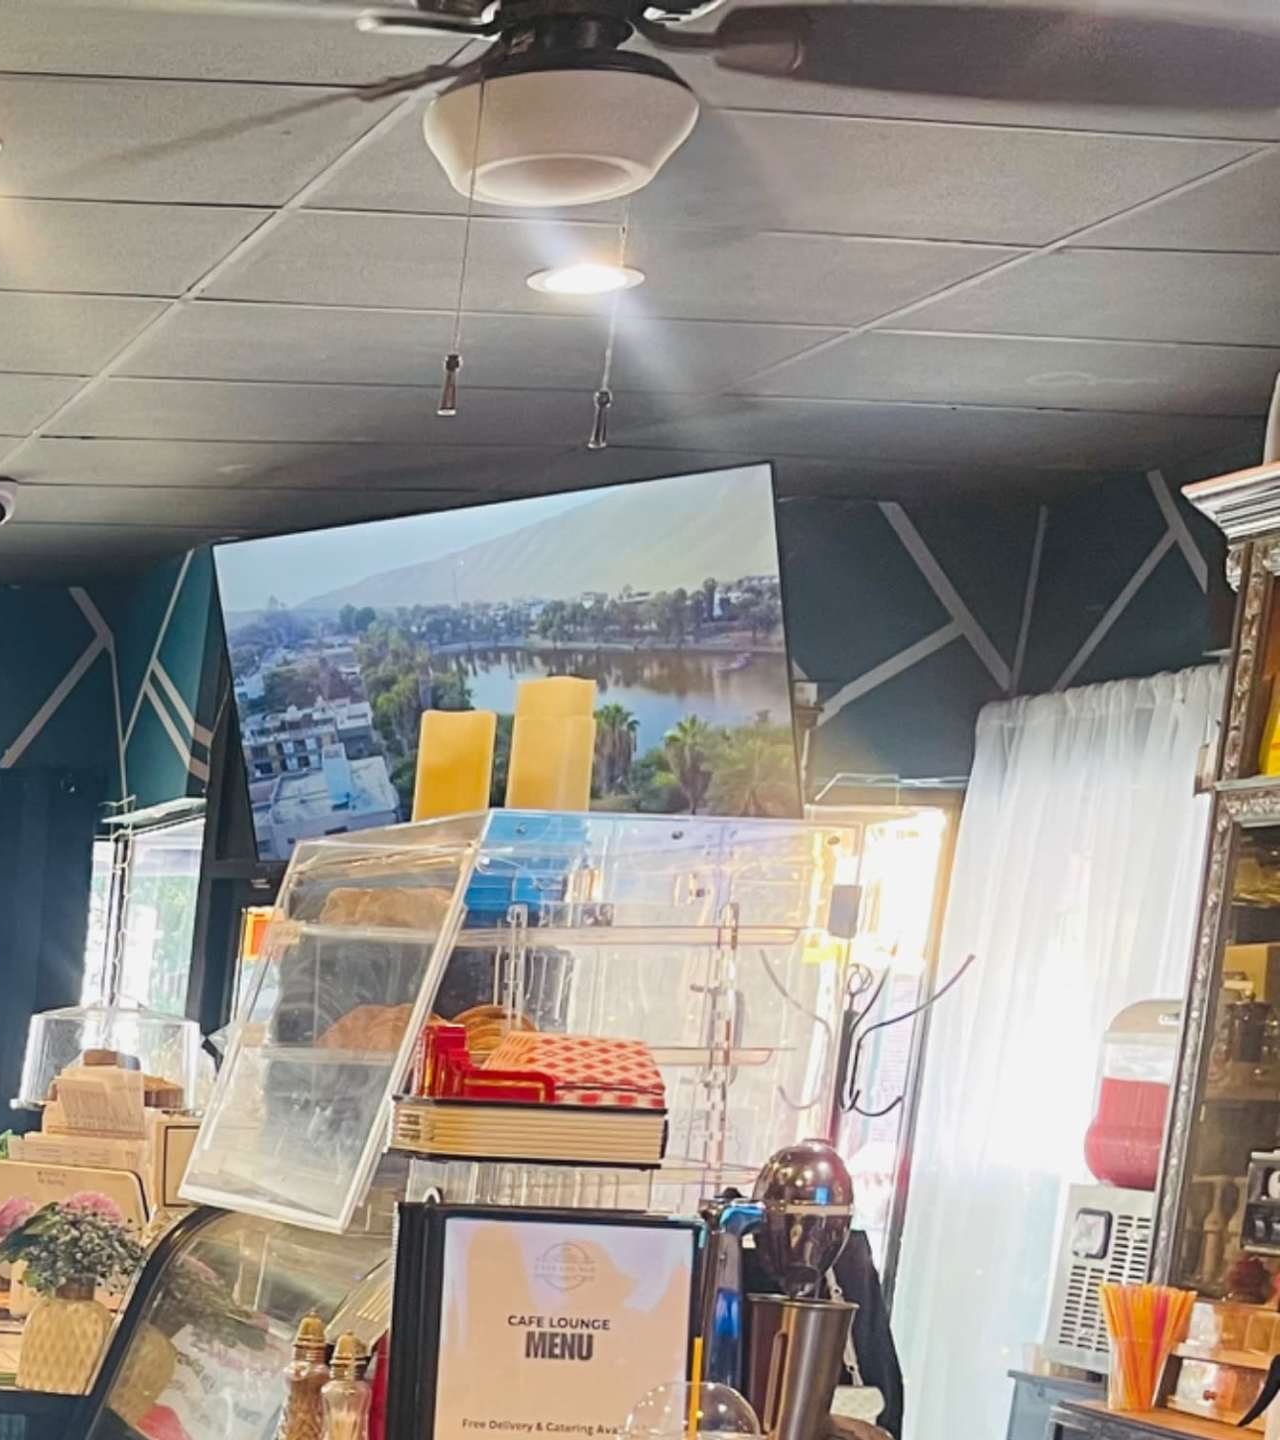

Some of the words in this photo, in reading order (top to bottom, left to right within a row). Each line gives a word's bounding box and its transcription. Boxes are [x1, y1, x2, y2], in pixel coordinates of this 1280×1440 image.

[507, 1315, 544, 1328] CAFE
[549, 1317, 610, 1330] LOUNGE
[525, 1331, 594, 1361] MENU
[462, 1418, 485, 1429] Free
[489, 1420, 533, 1433] Delivery
[536, 1422, 543, 1431] &
[546, 1422, 593, 1436] Catering
[596, 1424, 619, 1435] Ava
